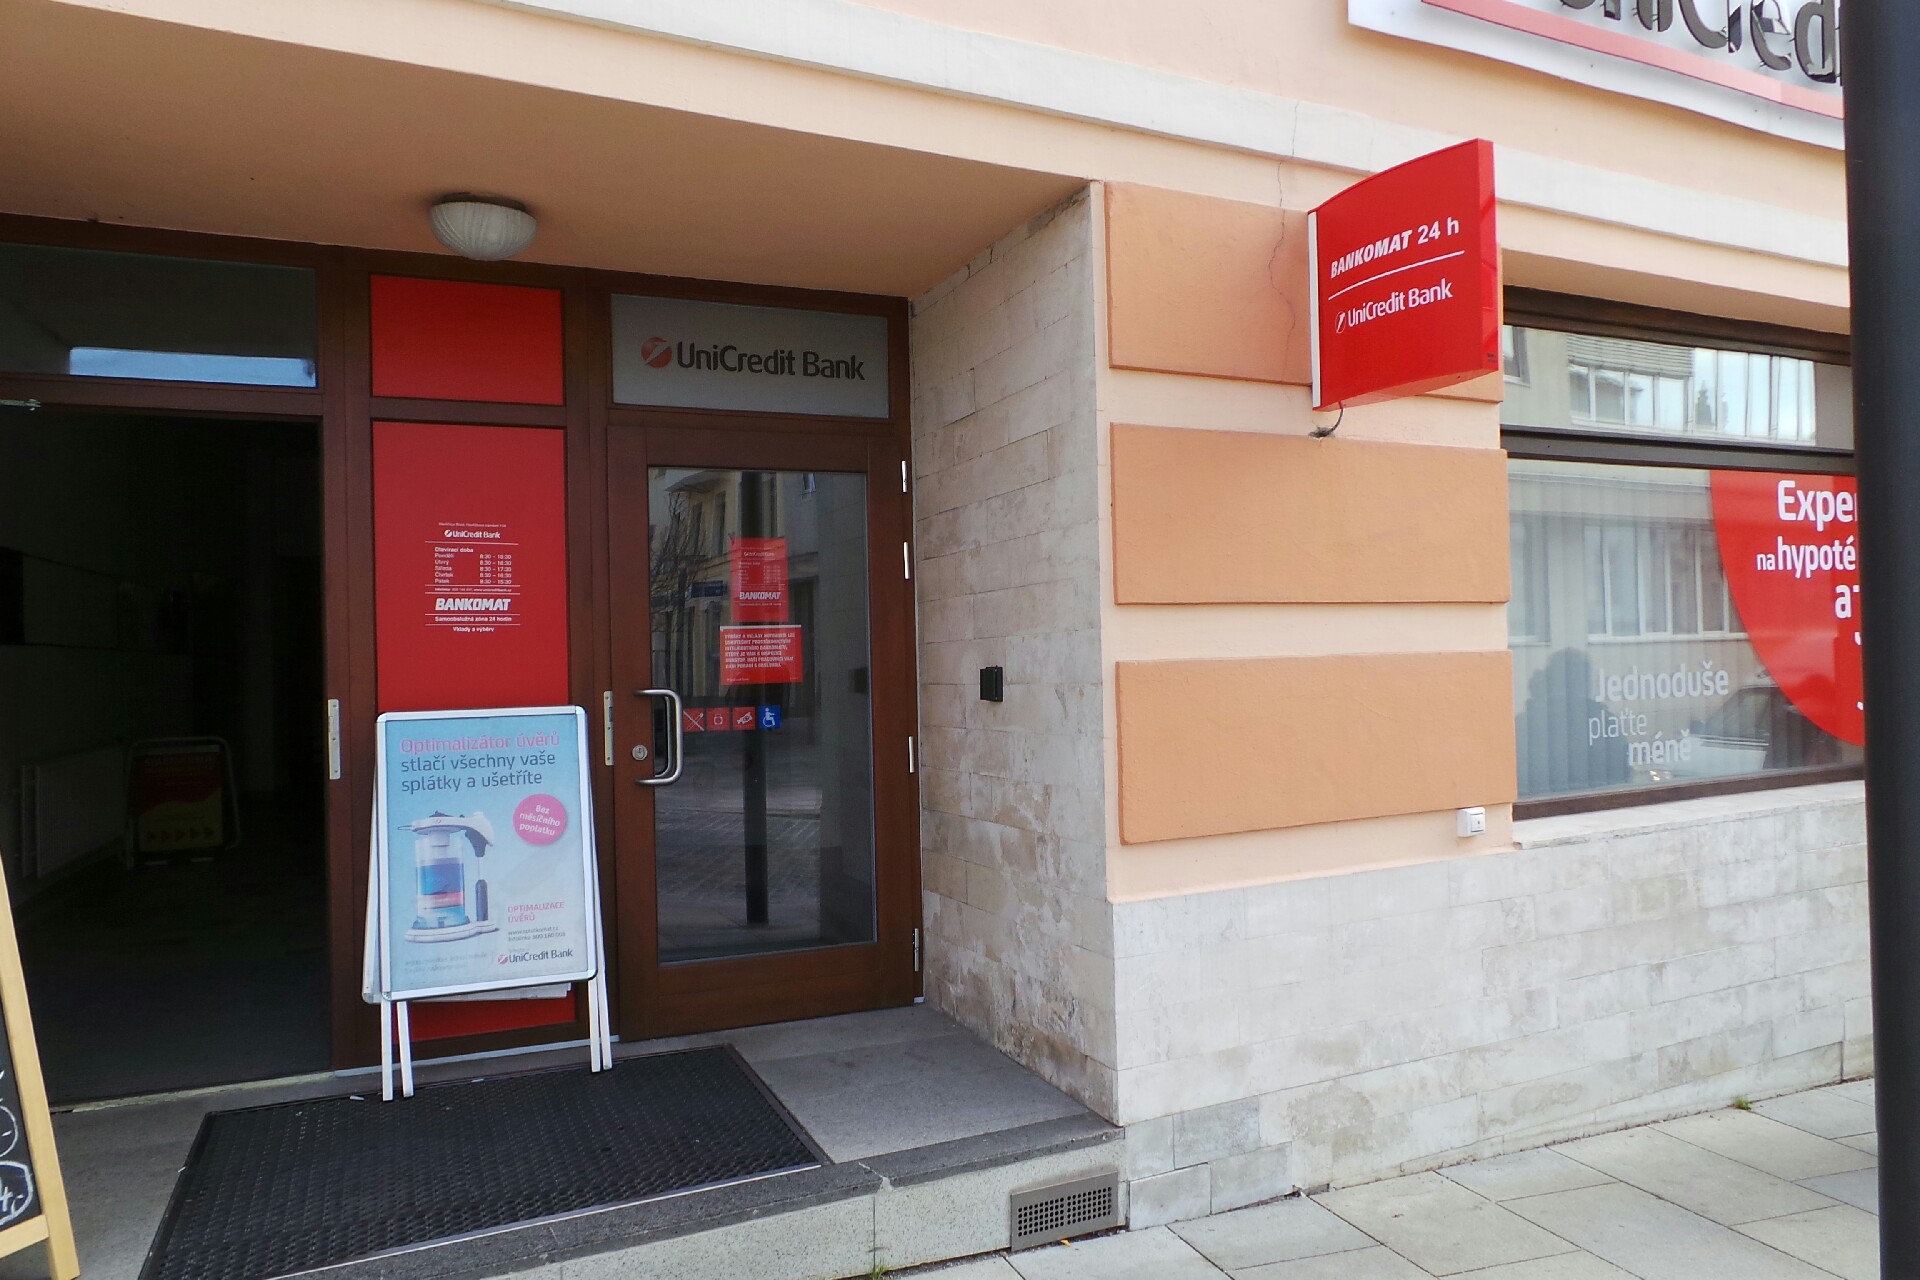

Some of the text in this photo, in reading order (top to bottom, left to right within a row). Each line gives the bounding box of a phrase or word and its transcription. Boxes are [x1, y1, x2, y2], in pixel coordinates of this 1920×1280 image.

[1330, 216, 1460, 279] BANKOMAT 24 h
[1347, 277, 1453, 328] UniCredit Bank
[676, 341, 866, 381] UniCredit Bank
[1777, 480, 1858, 532] Expe
[452, 530, 501, 539] UniCredit Bank
[1756, 535, 1857, 579] na hypoté
[435, 597, 512, 611] BANKOMAT
[739, 591, 781, 600] BANKOMAT
[1835, 583, 1860, 620] a
[1594, 660, 1730, 703] Jednoduše
[400, 731, 560, 755] Optimalizátor úvěrů
[1628, 728, 1691, 767] méně
[401, 750, 556, 772] stlačí všechny vaše
[401, 769, 542, 795] splátky a ušetříte
[519, 812, 560, 827] měsíčního
[535, 804, 550, 815] Bez
[519, 823, 555, 837] poplatku
[507, 901, 565, 914] OPTIMALIZACE
[507, 911, 535, 924] ÚVĚRŮ
[508, 950, 549, 963] UniCredit
[551, 948, 574, 959] Bank
